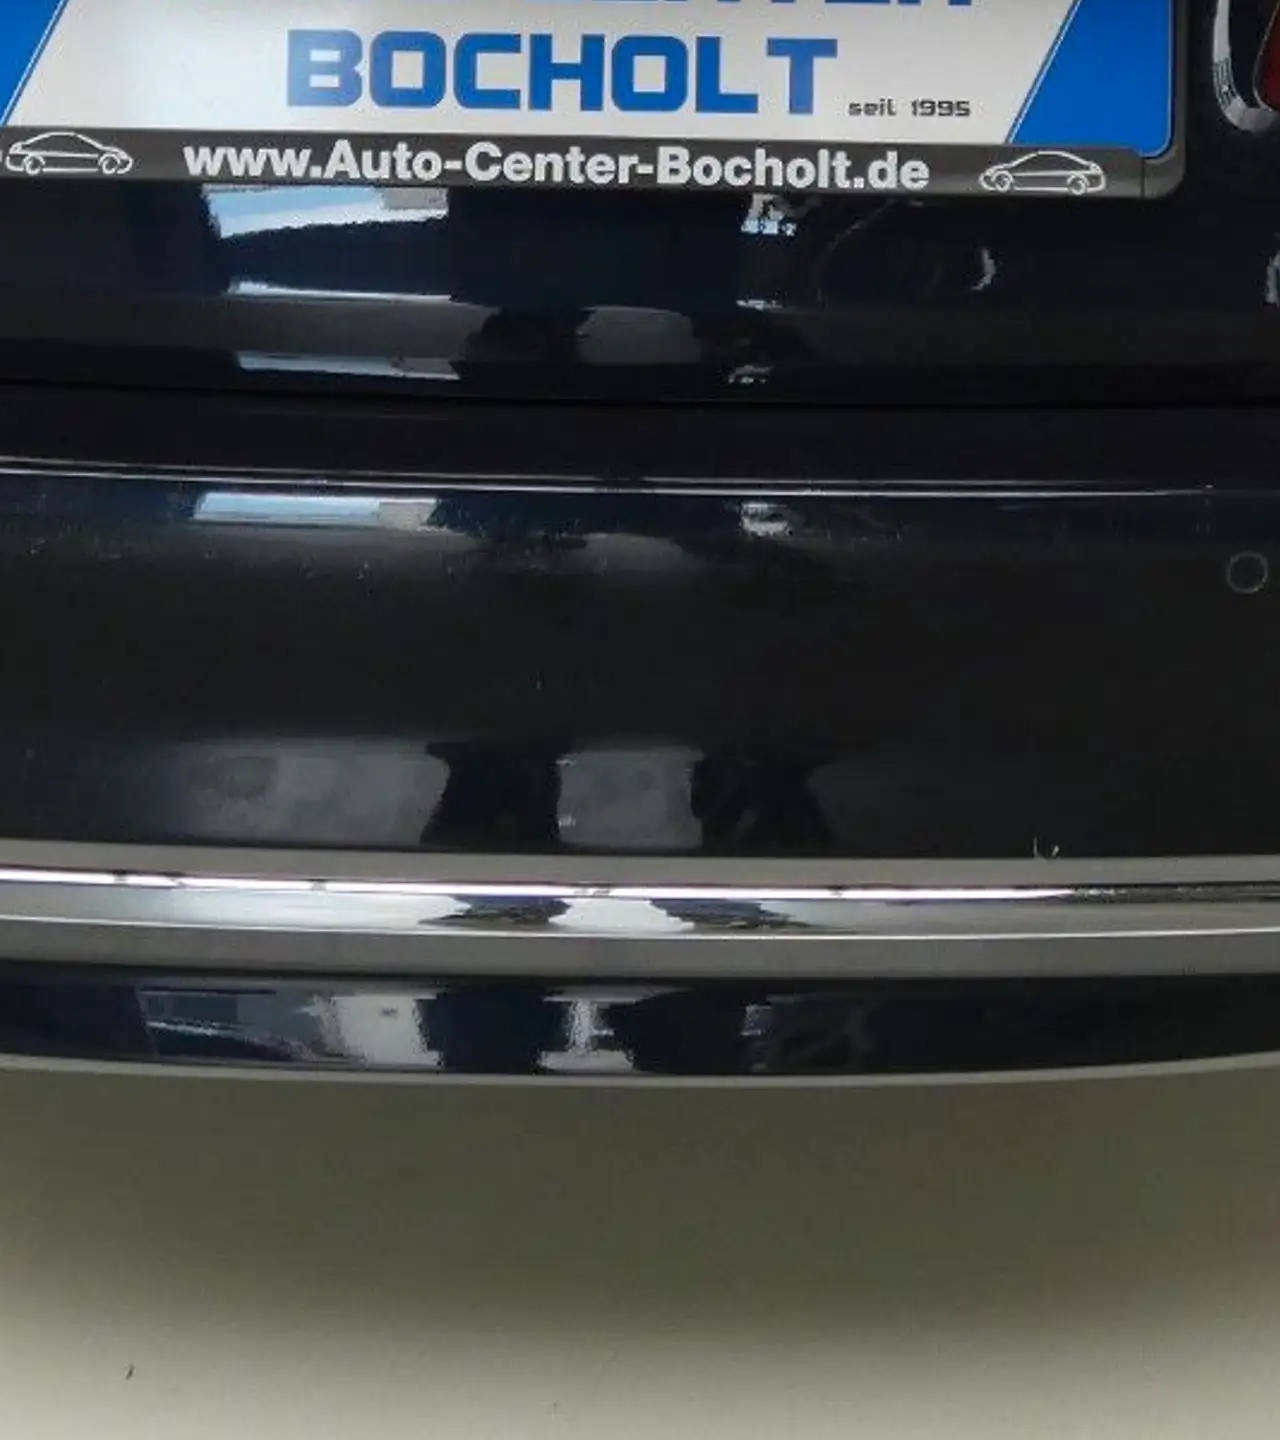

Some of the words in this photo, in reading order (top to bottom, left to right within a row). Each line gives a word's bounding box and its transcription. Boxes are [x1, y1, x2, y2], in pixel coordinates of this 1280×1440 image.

[287, 29, 837, 115] BOCHOLT
[911, 100, 971, 116] 1995
[183, 139, 931, 191] www.Auto-Center-Bocholt.de
